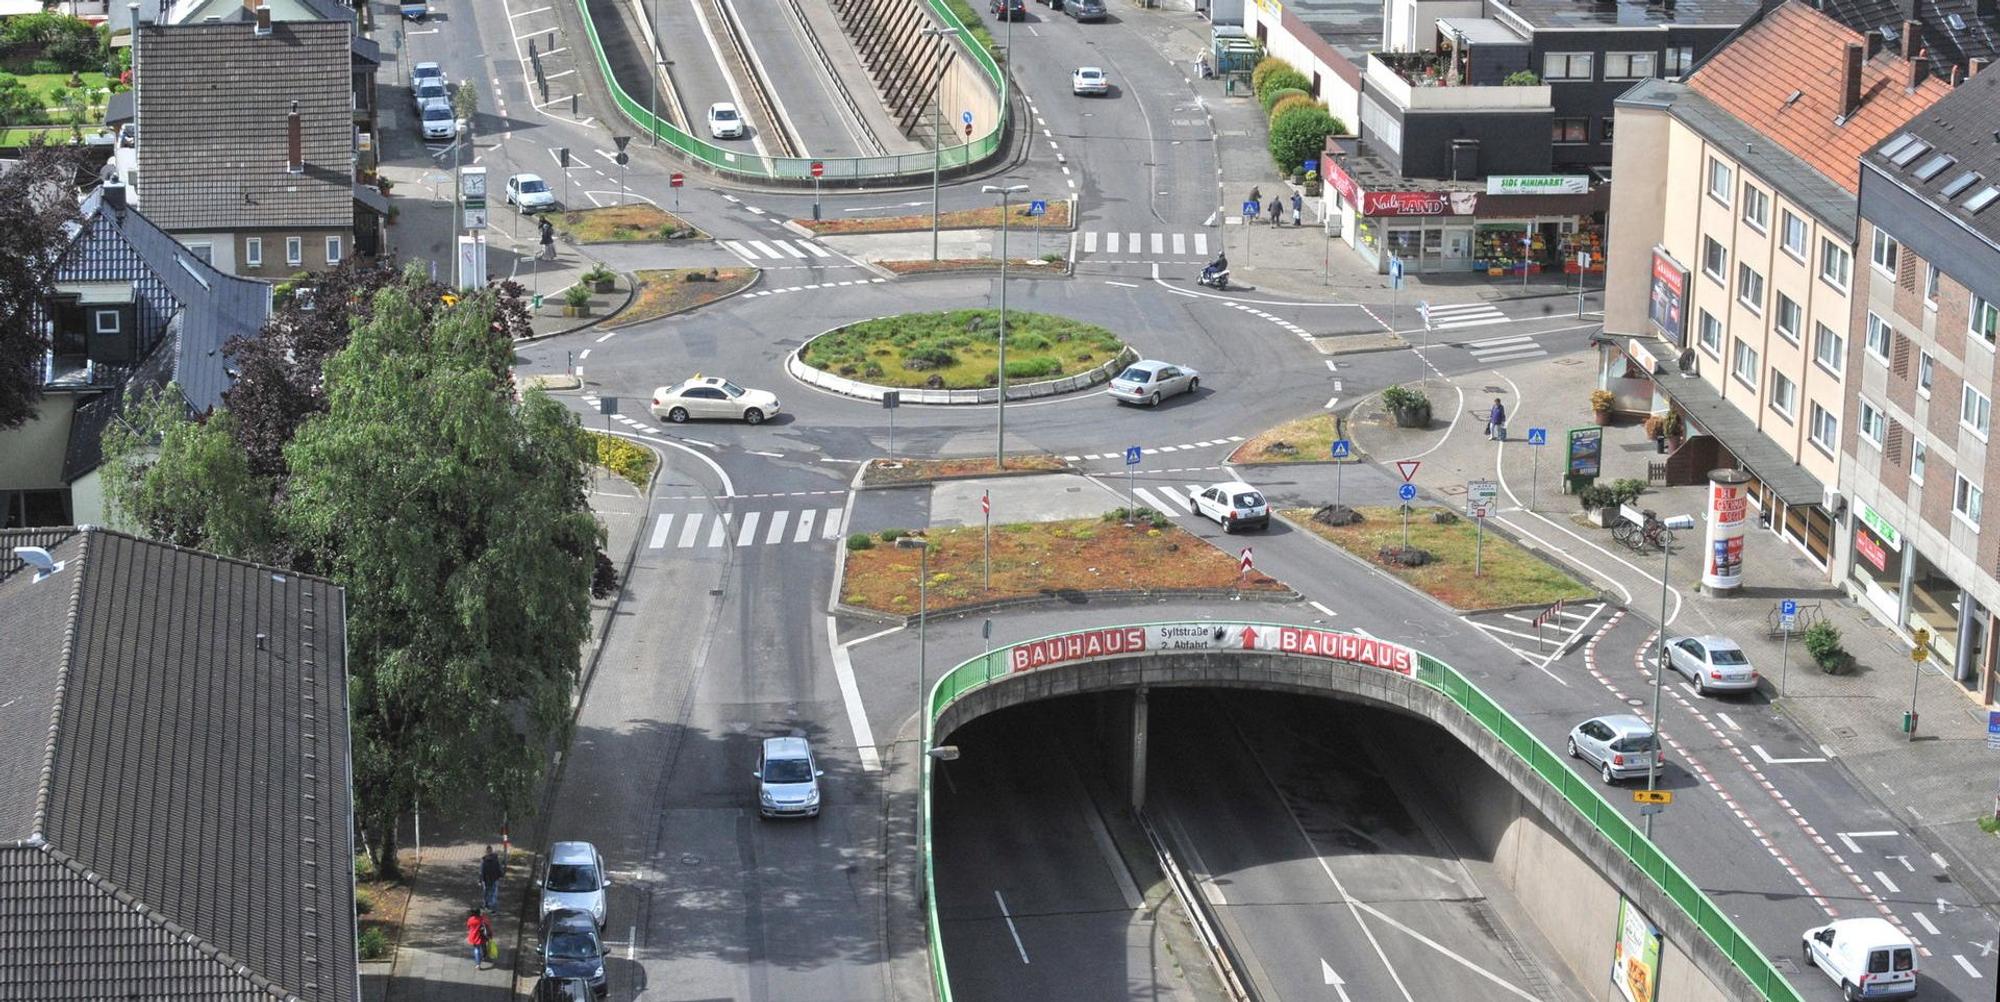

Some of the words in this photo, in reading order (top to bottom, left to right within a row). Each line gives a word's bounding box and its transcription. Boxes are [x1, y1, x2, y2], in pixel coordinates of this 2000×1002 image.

[1397, 199, 1444, 215] LAND
[1160, 626, 1209, 639] Syltstraße
[1014, 630, 1143, 670] BAUHAUS
[1174, 640, 1209, 650] Abfahrt
[1282, 630, 1409, 670] BAUHAUS
